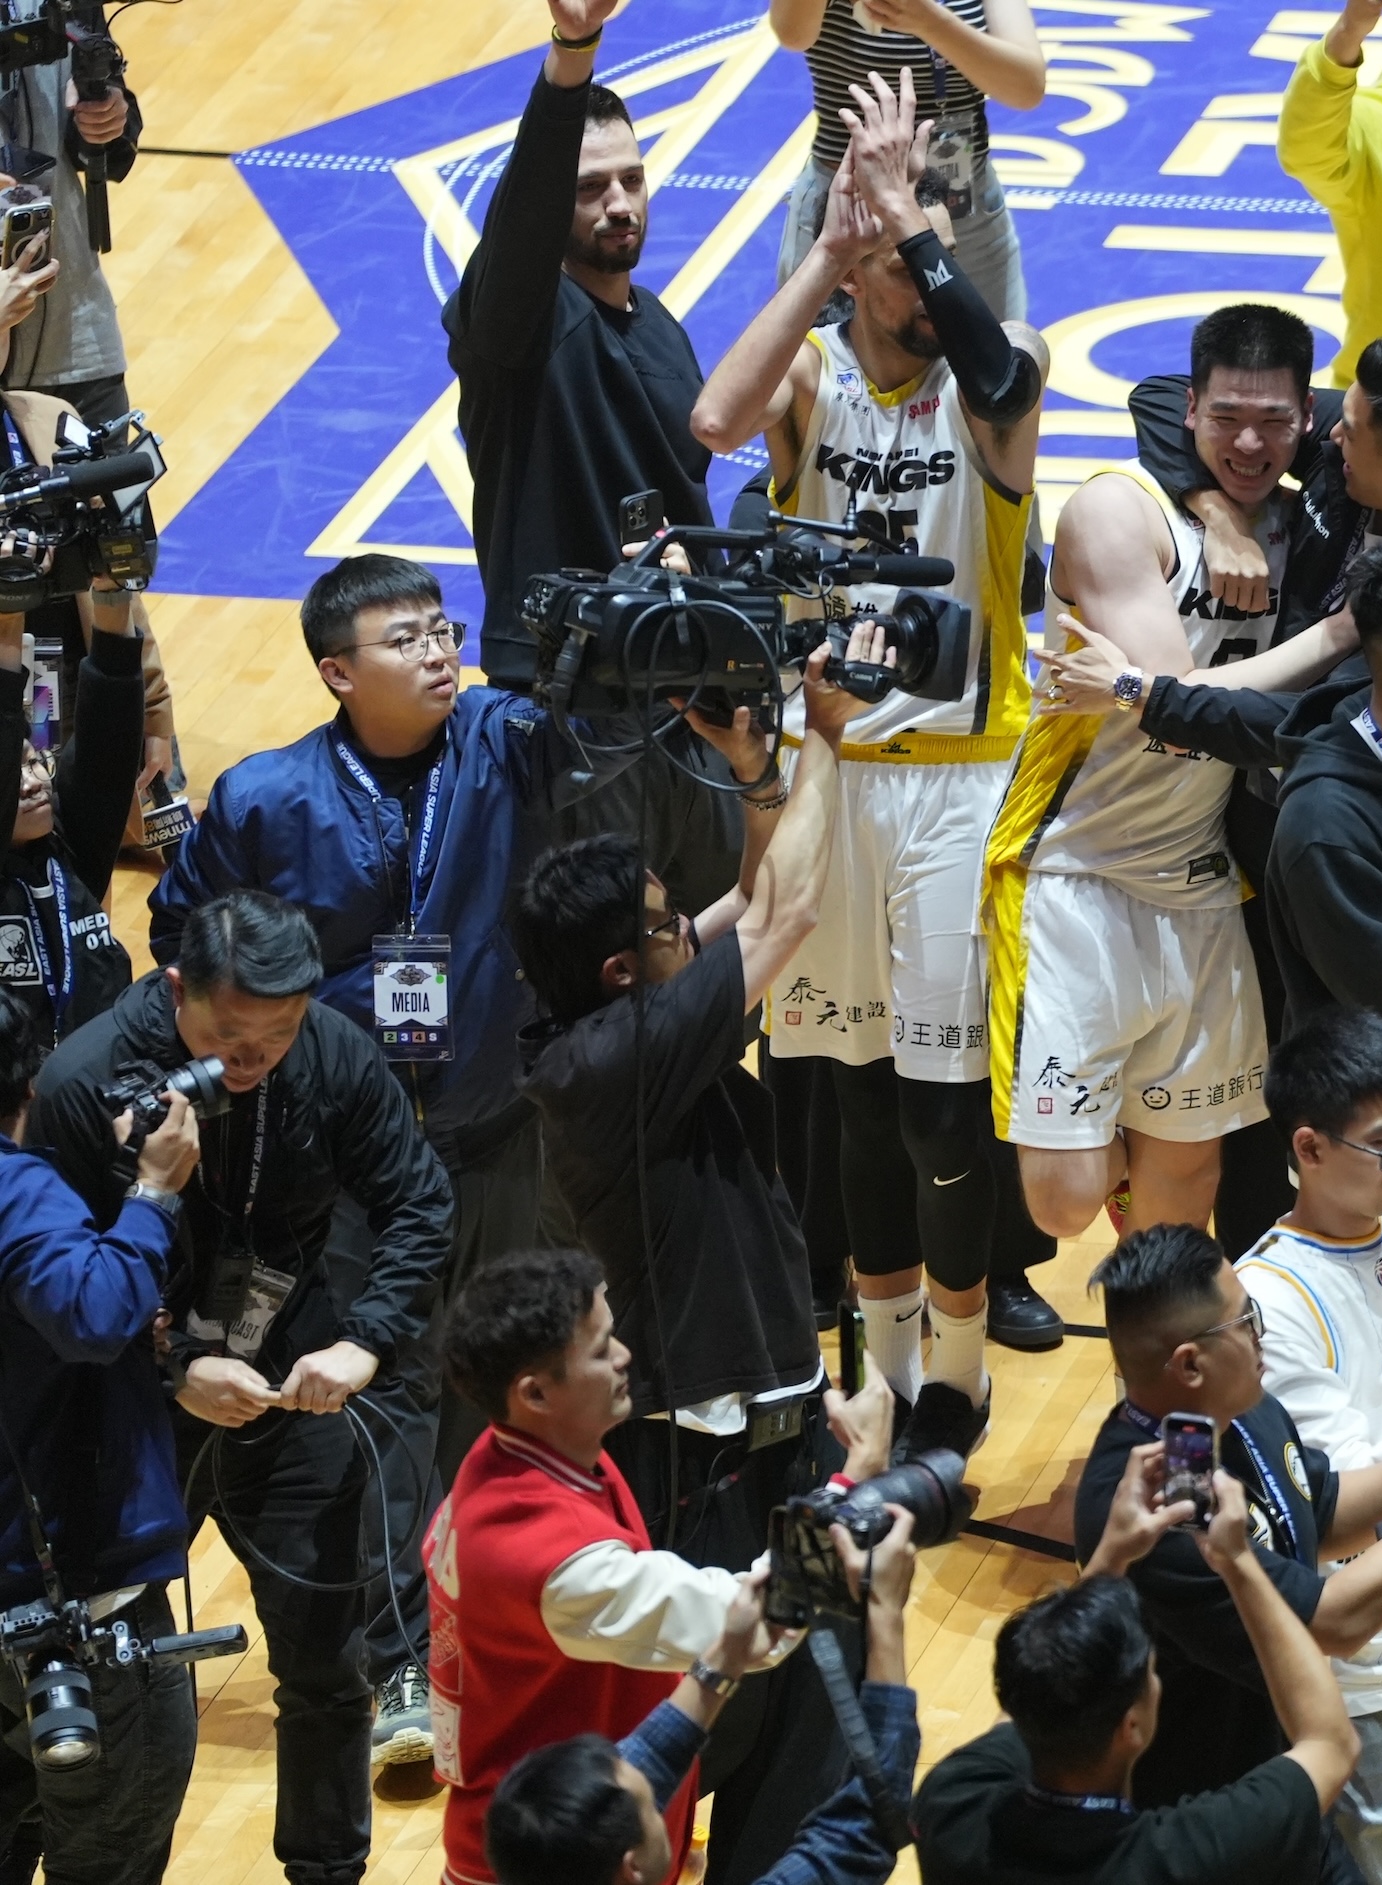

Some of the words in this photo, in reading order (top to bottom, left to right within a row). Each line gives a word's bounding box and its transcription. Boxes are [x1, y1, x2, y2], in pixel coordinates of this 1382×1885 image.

[815, 443, 956, 495] KINGS
[428, 767, 442, 794] ASIA
[423, 793, 437, 832] SUPER
[416, 830, 432, 878] LEAGUE
[55, 886, 67, 911] ASIA
[69, 911, 110, 937] MED
[38, 946, 52, 976] EAST
[391, 992, 431, 1013] MEDIA
[910, 1022, 985, 1049] 王道銀
[1178, 1064, 1265, 1111] 王道銀行
[255, 1099, 268, 1135] SUPER
[253, 1135, 265, 1168] ASIA
[249, 1166, 262, 1194] EAST
[1250, 1446, 1269, 1473] ASIA
[1264, 1473, 1290, 1515] SUPER
